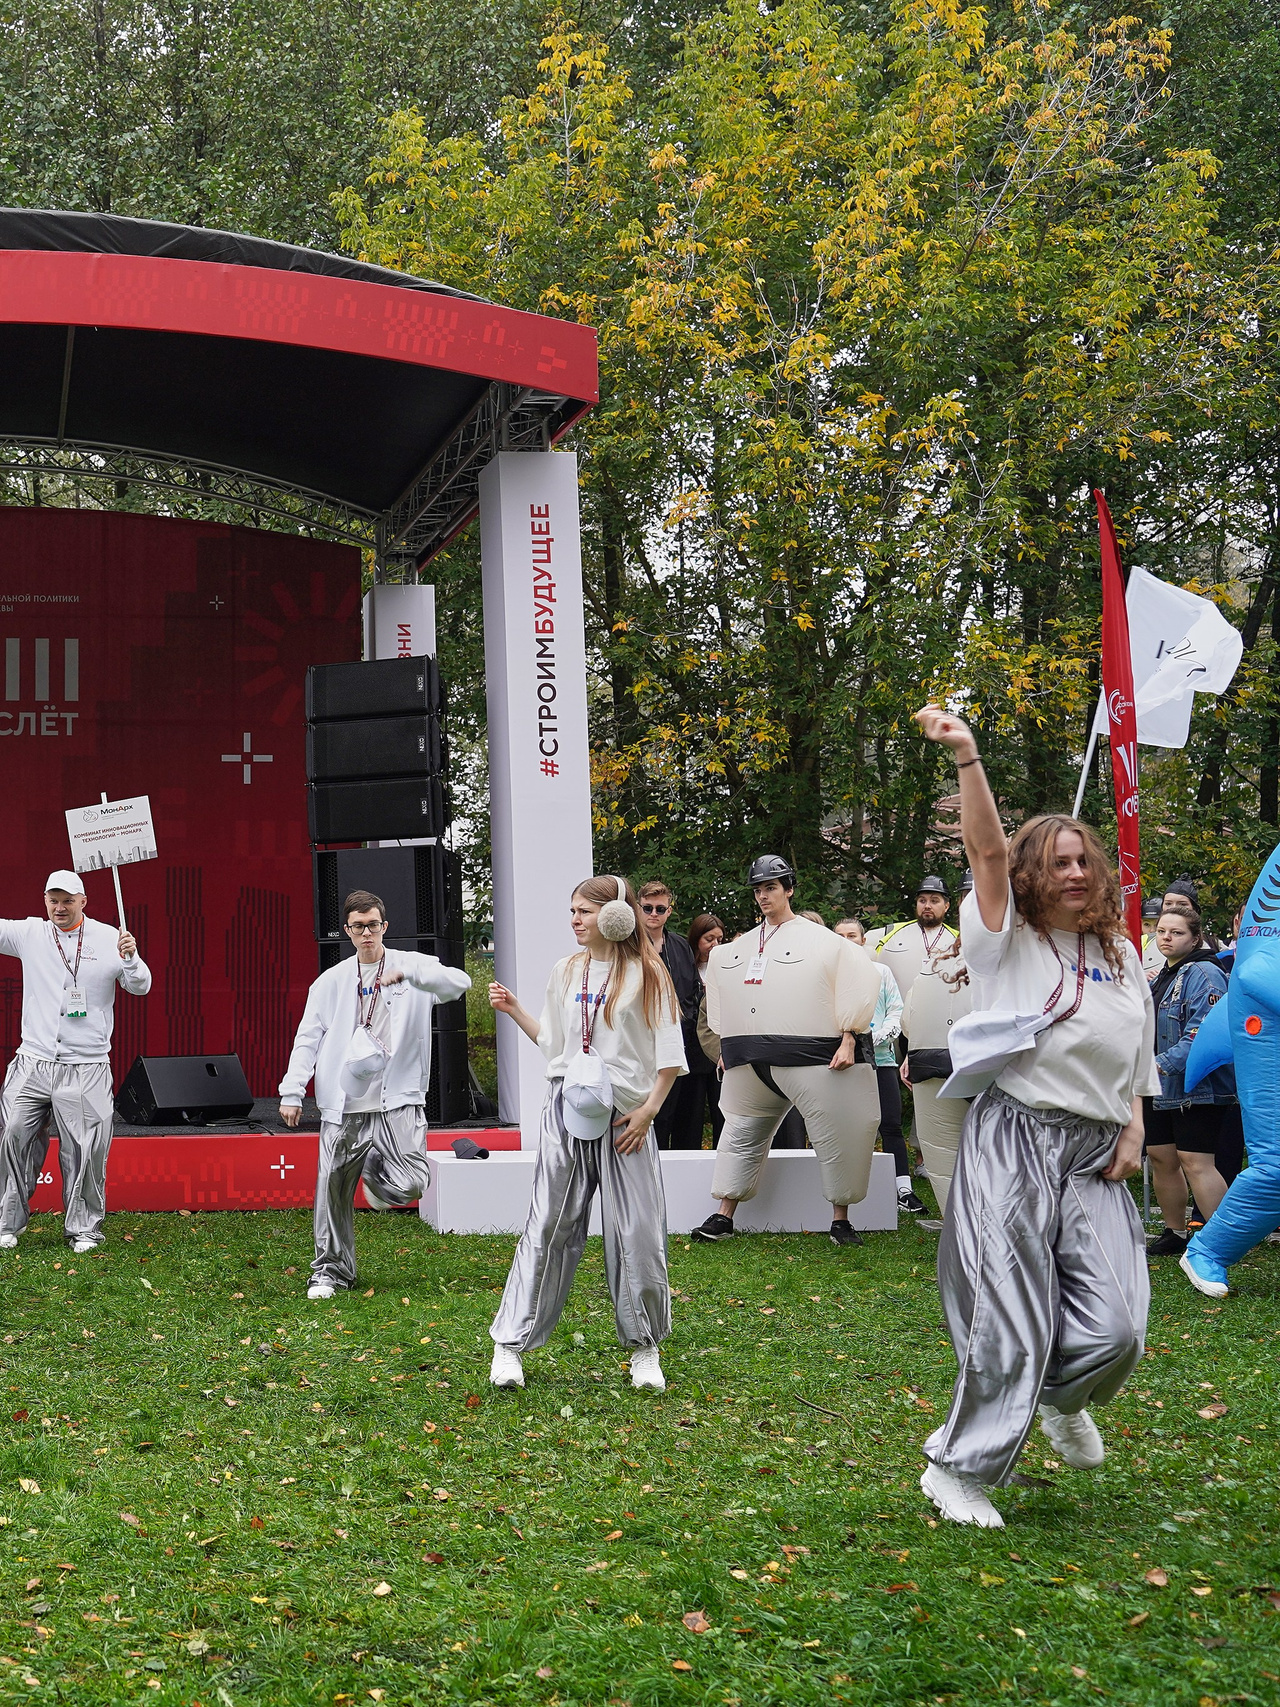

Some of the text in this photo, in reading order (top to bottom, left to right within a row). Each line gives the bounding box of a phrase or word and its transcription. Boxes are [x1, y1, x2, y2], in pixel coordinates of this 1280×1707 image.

[33, 594, 80, 603] ПОЛИТИКИ
[530, 503, 560, 778] #СТРОИМБУДУЩЕЕ
[100, 804, 133, 815] МонАрх
[74, 820, 149, 839] КОМБИНАТ ИННОВАЦИОННЫХ
[81, 831, 116, 843] ТЕХНОЛОГИЙ
[120, 827, 143, 836] МОНАРХ
